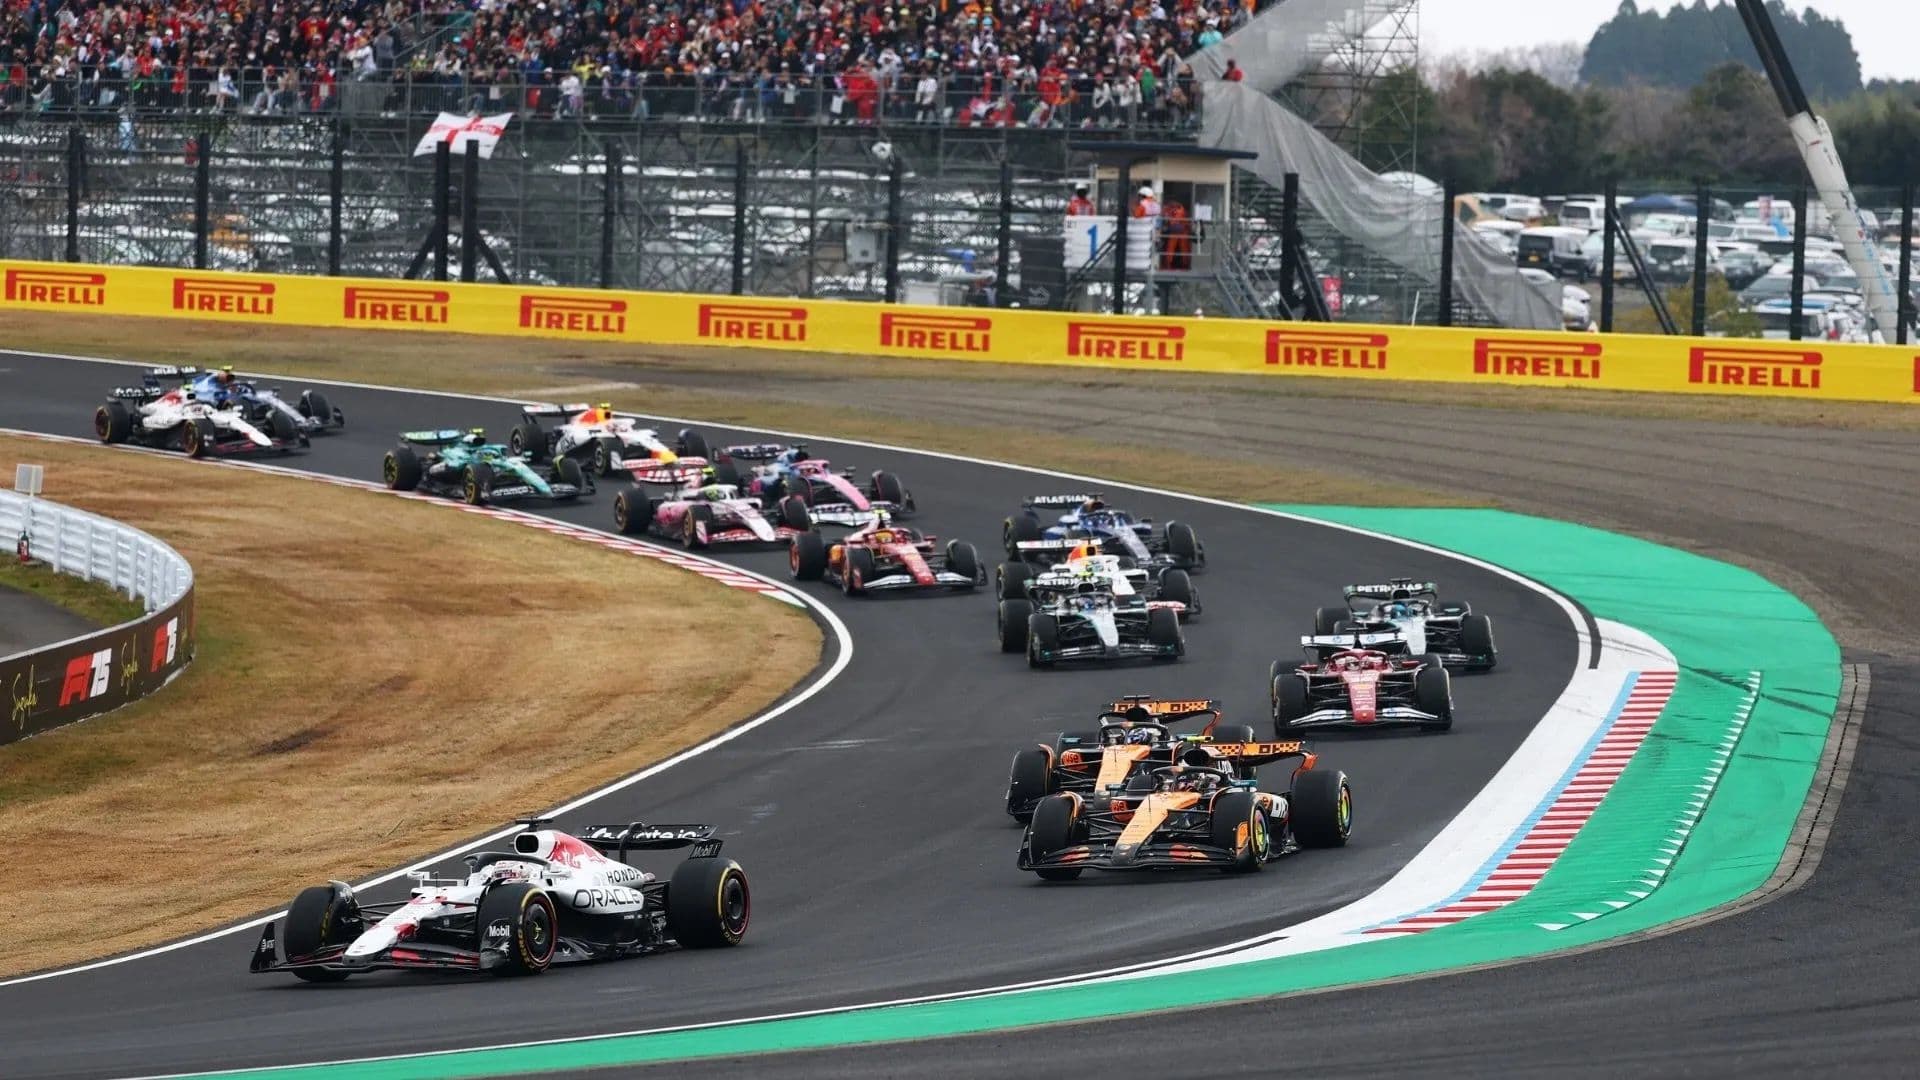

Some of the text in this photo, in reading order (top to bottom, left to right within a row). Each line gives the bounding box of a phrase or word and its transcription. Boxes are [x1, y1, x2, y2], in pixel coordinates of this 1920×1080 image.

[1087, 223, 1097, 260] 1
[5, 269, 106, 305] PIRELLI
[173, 278, 275, 314] PIRELLI
[344, 287, 449, 323] PIRELLI
[520, 295, 626, 333] PIRELLI
[699, 303, 807, 341] PIRELLI
[880, 312, 991, 352] PIRELLI
[1067, 321, 1186, 361] PIRELLI
[1265, 329, 1388, 369] PIRELLI
[1474, 338, 1602, 378] PIRELLI
[1688, 347, 1822, 388] PIRELLI
[1034, 495, 1090, 503] ATLASIAN
[1357, 583, 1423, 592] PETRAS
[573, 889, 640, 908] ORACLE
[489, 924, 510, 937] Mobil
